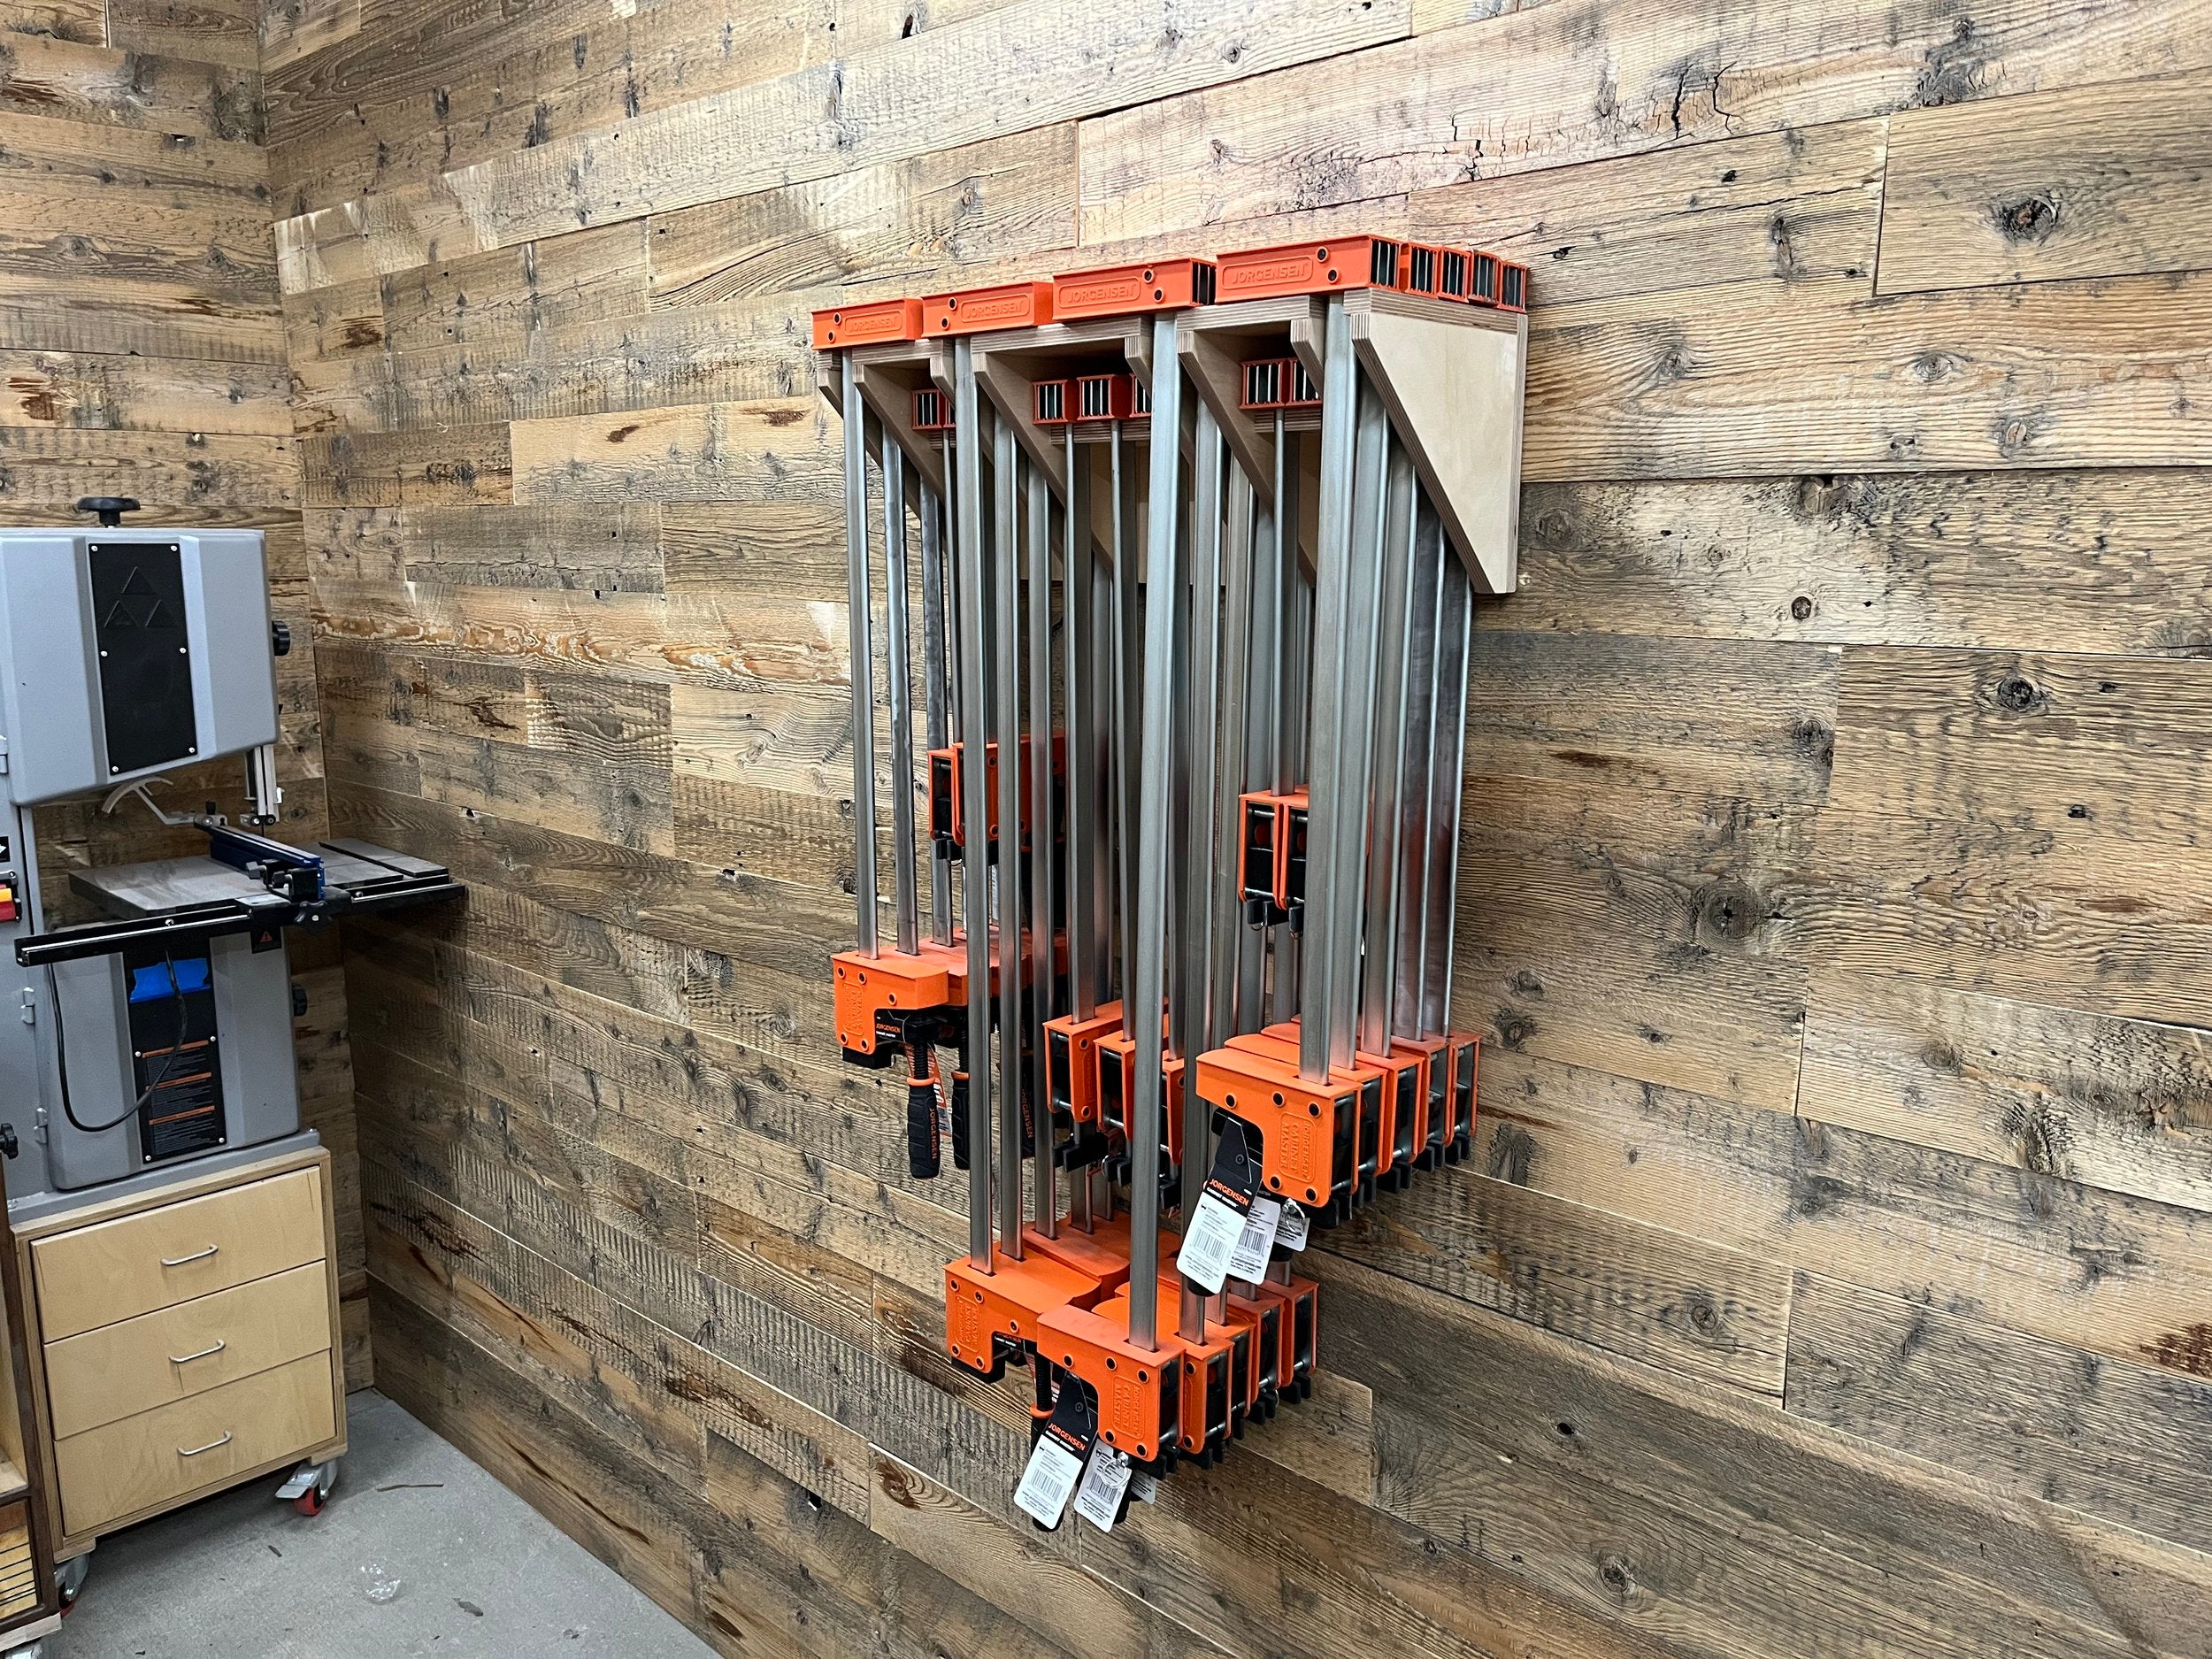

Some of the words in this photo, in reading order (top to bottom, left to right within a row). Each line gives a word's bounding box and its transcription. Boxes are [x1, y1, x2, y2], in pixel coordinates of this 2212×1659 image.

[1232, 265, 1306, 284] JORGENSEN
[1067, 283, 1136, 303] JORGENSEN
[966, 300, 1024, 318] JORGENSEN
[849, 315, 896, 333] JORGENSEN
[929, 1107, 938, 1160] JORGENSEN
[1210, 1179, 1249, 1206] JORGENSEN
[1047, 1423, 1087, 1451] JORGENSEN
